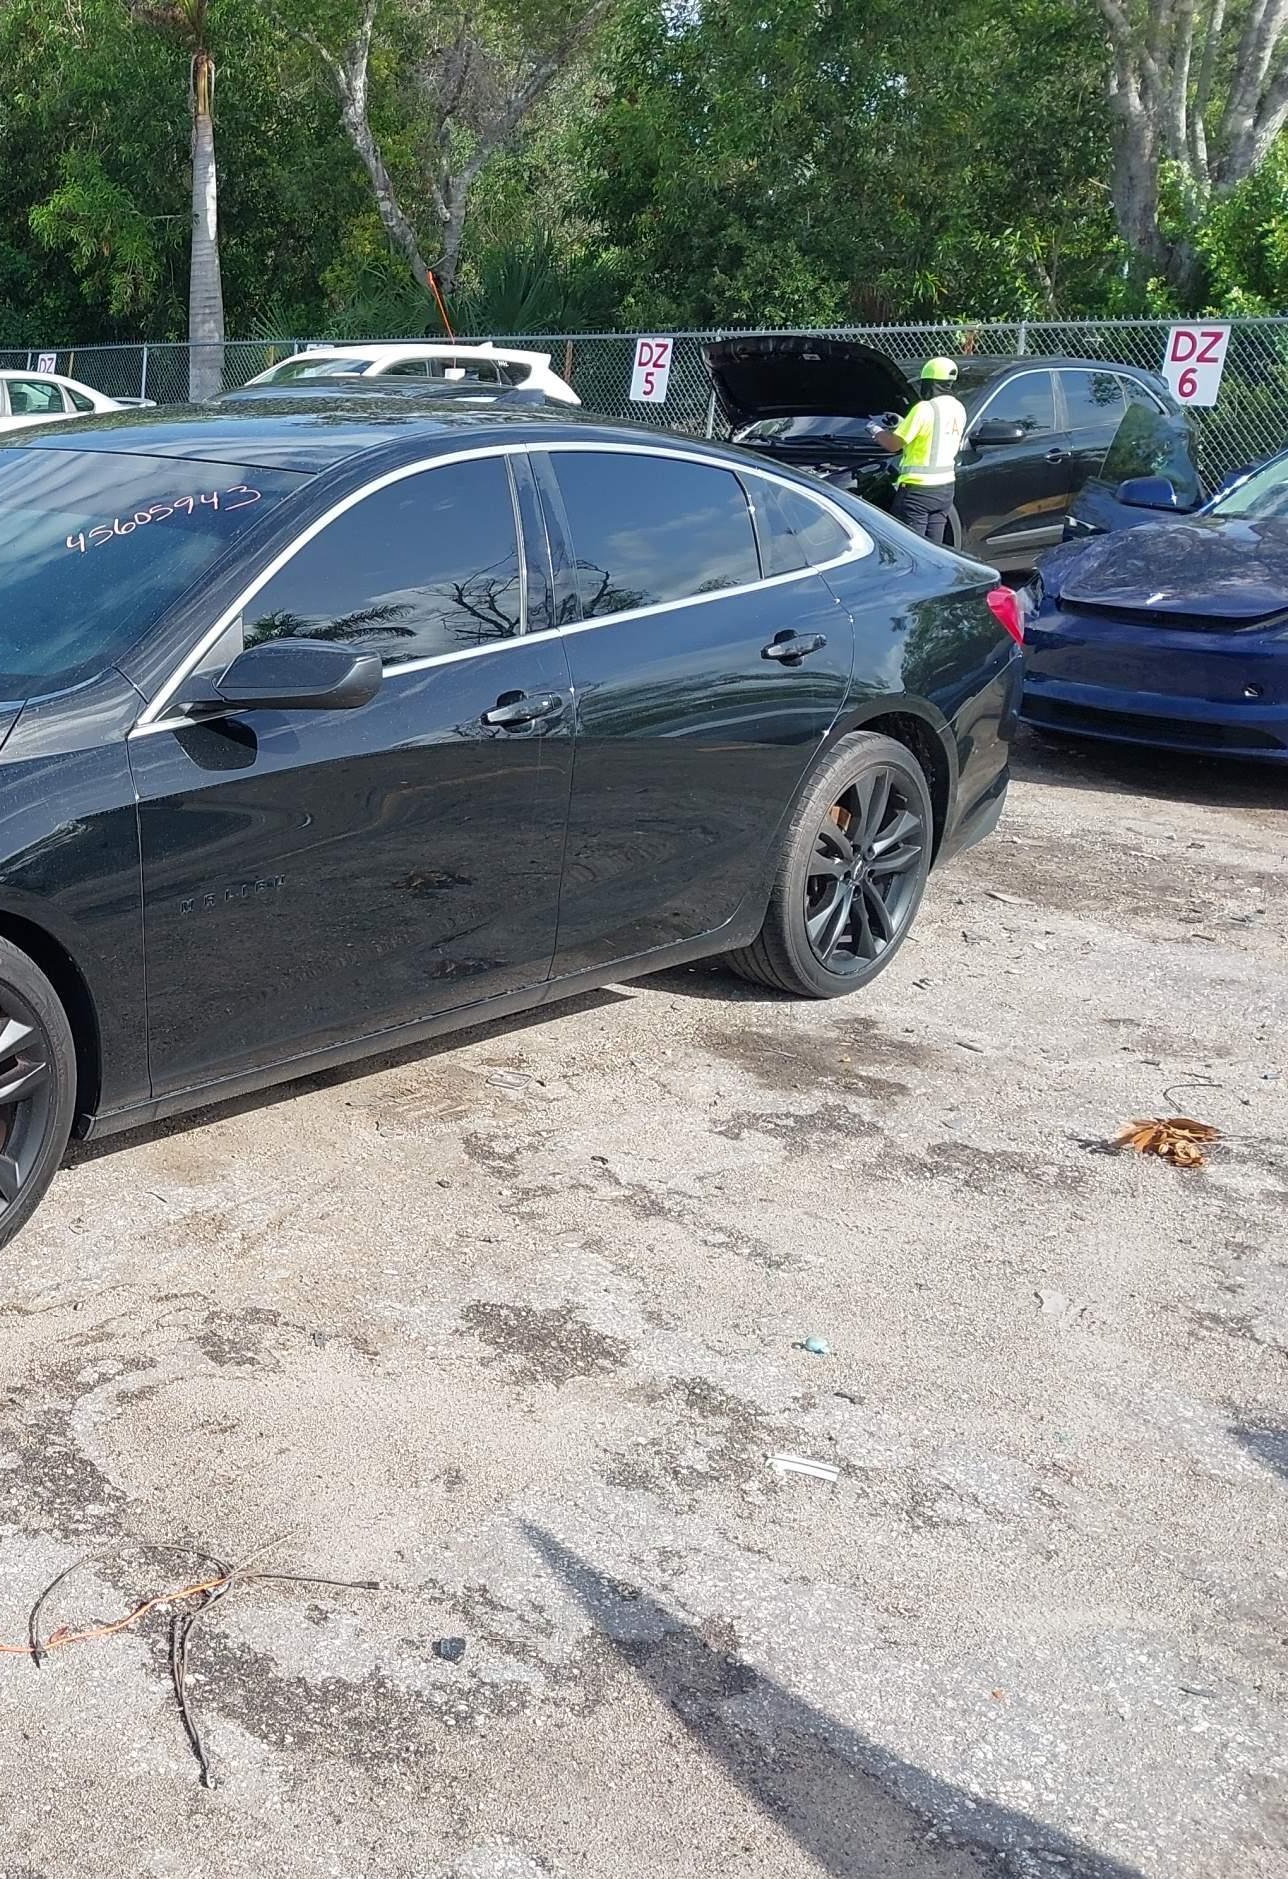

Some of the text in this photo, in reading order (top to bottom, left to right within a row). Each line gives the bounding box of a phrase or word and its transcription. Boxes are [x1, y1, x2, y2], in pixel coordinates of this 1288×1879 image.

[638, 342, 669, 368] DZ
[1170, 330, 1224, 363] DZ
[642, 371, 655, 396] 5
[1178, 367, 1198, 398] 6
[66, 484, 262, 553] 45605943
